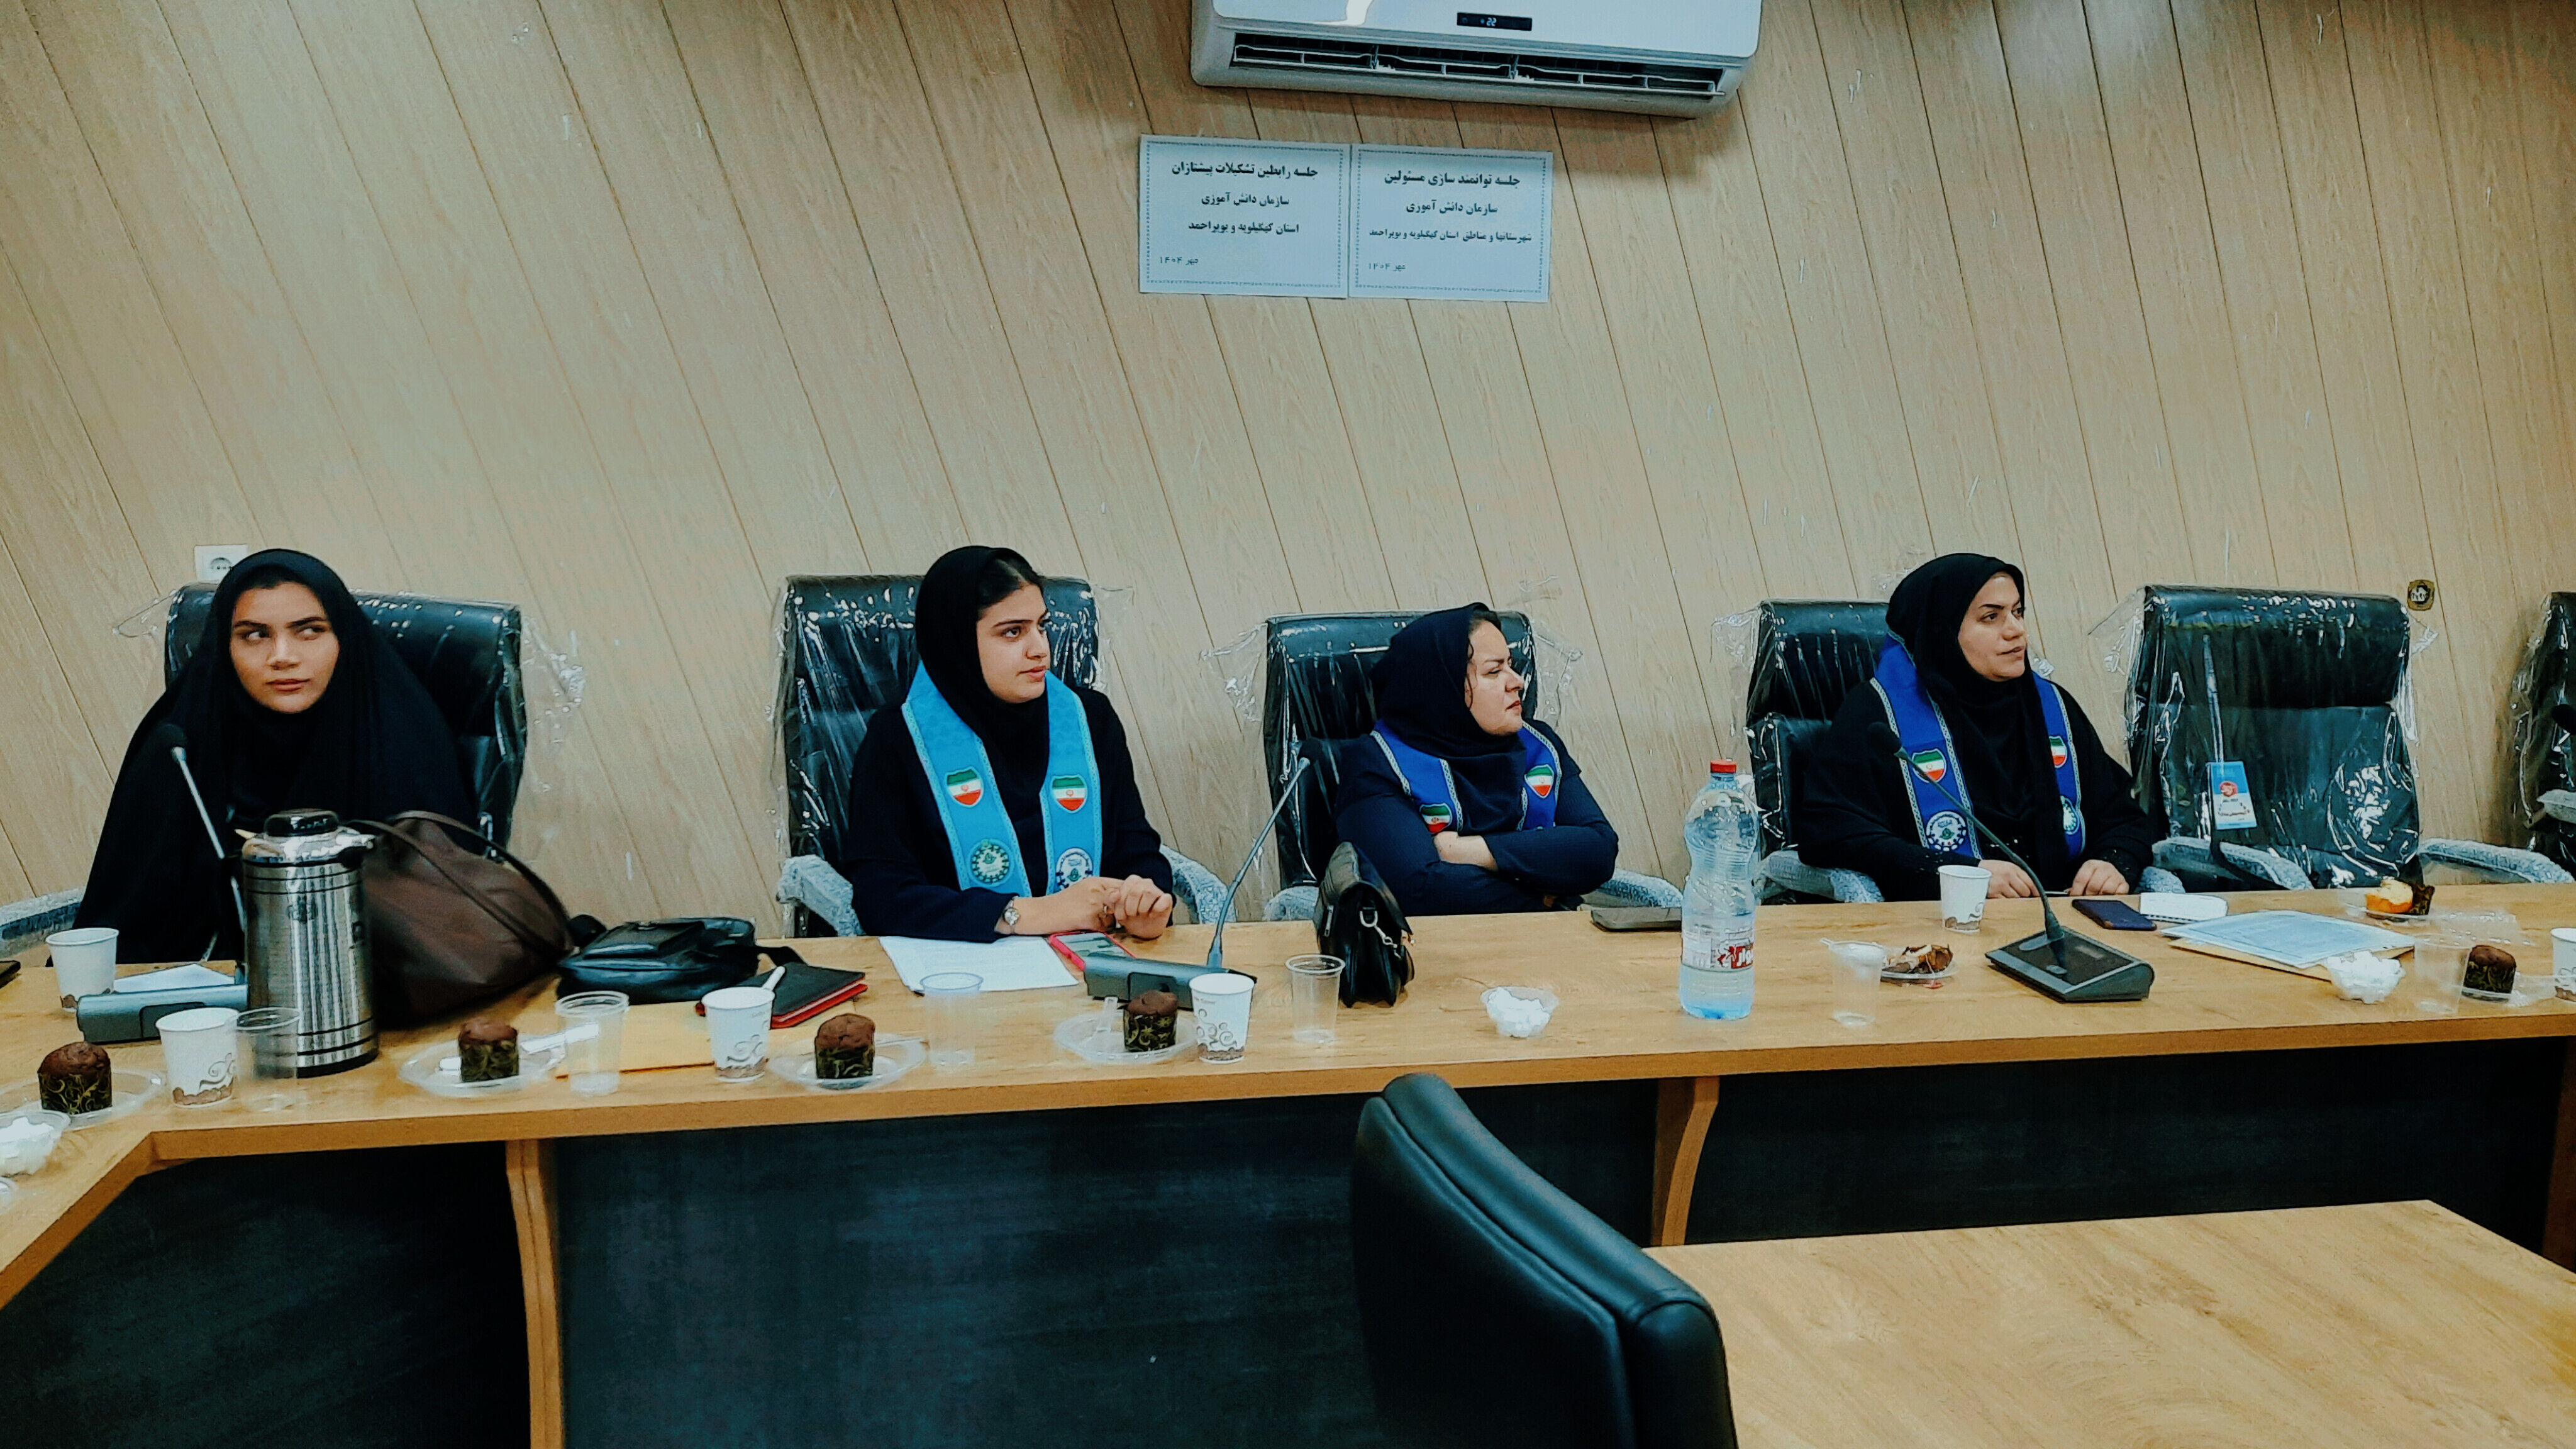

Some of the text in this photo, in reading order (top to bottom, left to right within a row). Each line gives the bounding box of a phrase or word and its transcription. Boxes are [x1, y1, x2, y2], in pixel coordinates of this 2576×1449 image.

[1486, 17, 1497, 26] 22
[1172, 161, 1319, 180] جلسه رابطین تشکیلات پیشتازان
[1384, 170, 1521, 189] جلسه توانمند سازی مسئولین
[1201, 192, 1289, 208] سازمان دانش آموزی
[1406, 199, 1498, 216] سازمان دانش آموزی
[1230, 225, 1236, 234] و
[1275, 223, 1299, 235] استان
[1440, 231, 1459, 241] استان
[1462, 231, 1487, 242] مناطق
[1488, 235, 1494, 243] و
